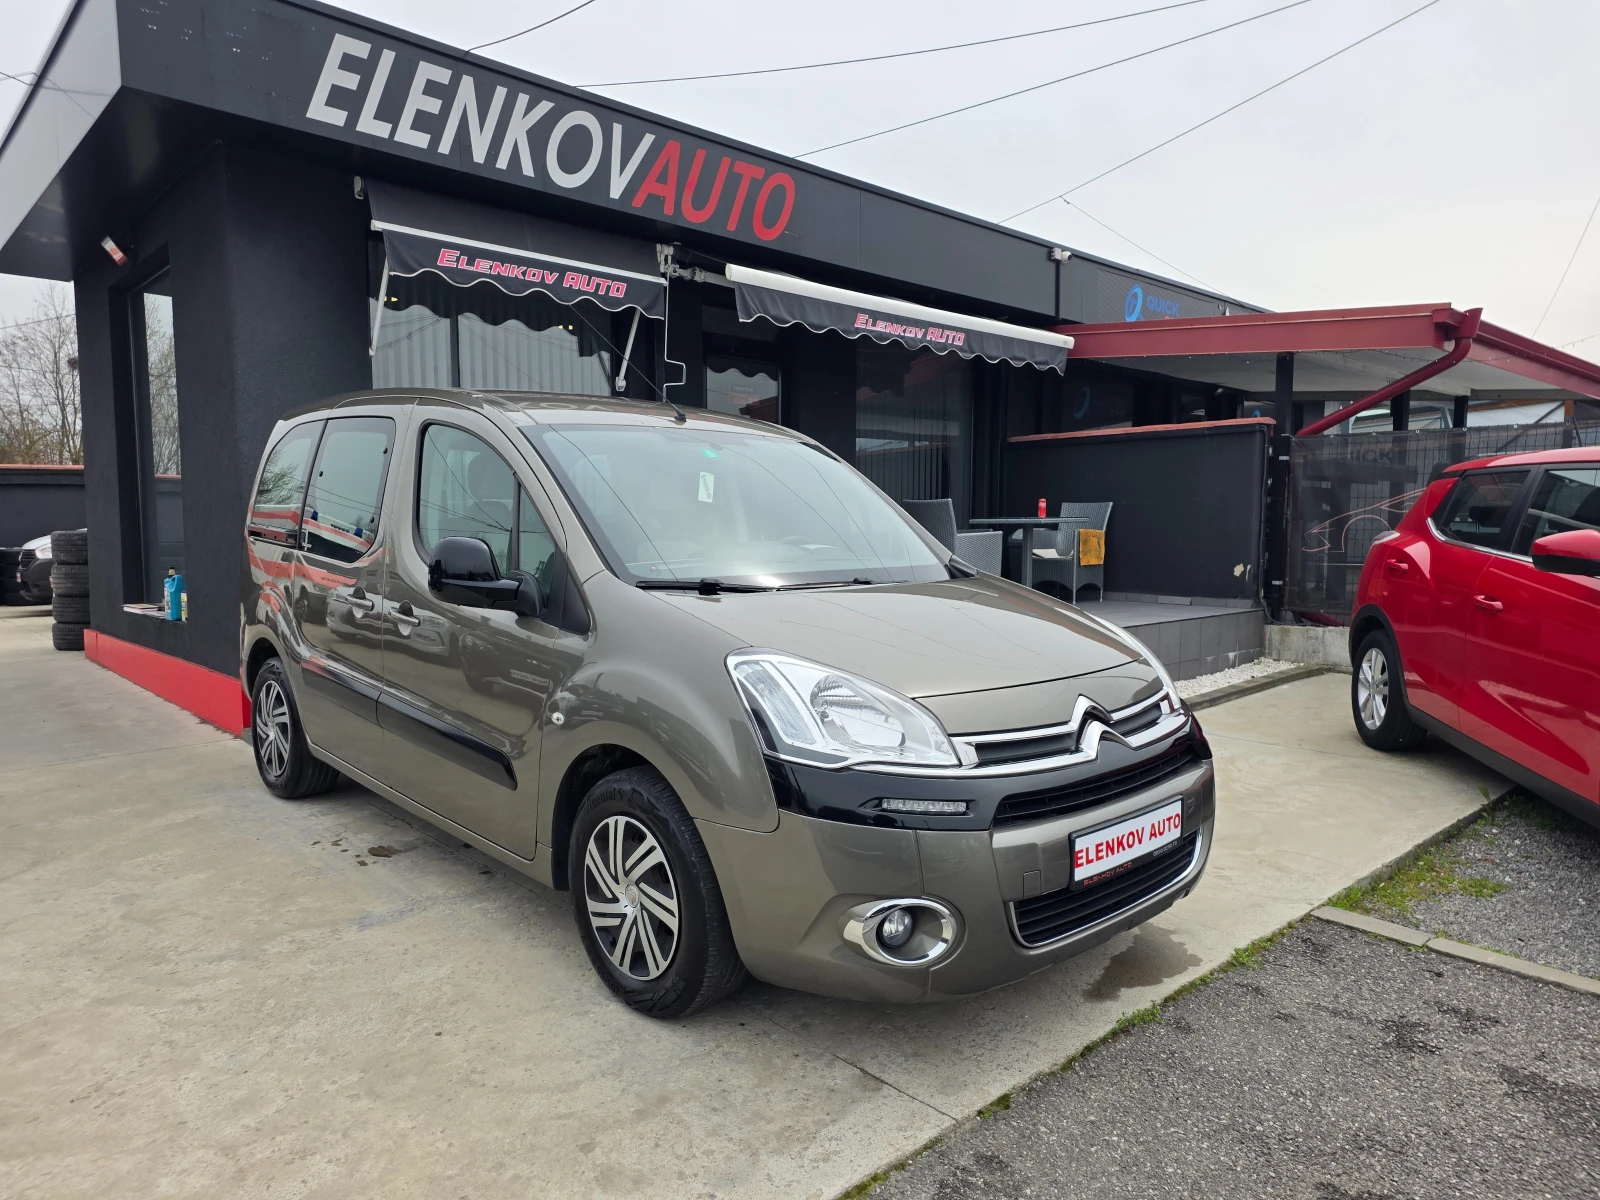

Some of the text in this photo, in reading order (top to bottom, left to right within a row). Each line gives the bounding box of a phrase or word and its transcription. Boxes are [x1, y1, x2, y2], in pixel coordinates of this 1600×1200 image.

[437, 248, 627, 298] ELENKOV AUTO
[1146, 295, 1180, 317] QUICK
[854, 313, 966, 346] ELENKOV AUTO
[1074, 826, 1145, 869] ELENKOV
[1148, 812, 1181, 841] AUTO
[1115, 861, 1133, 874] AUTO
